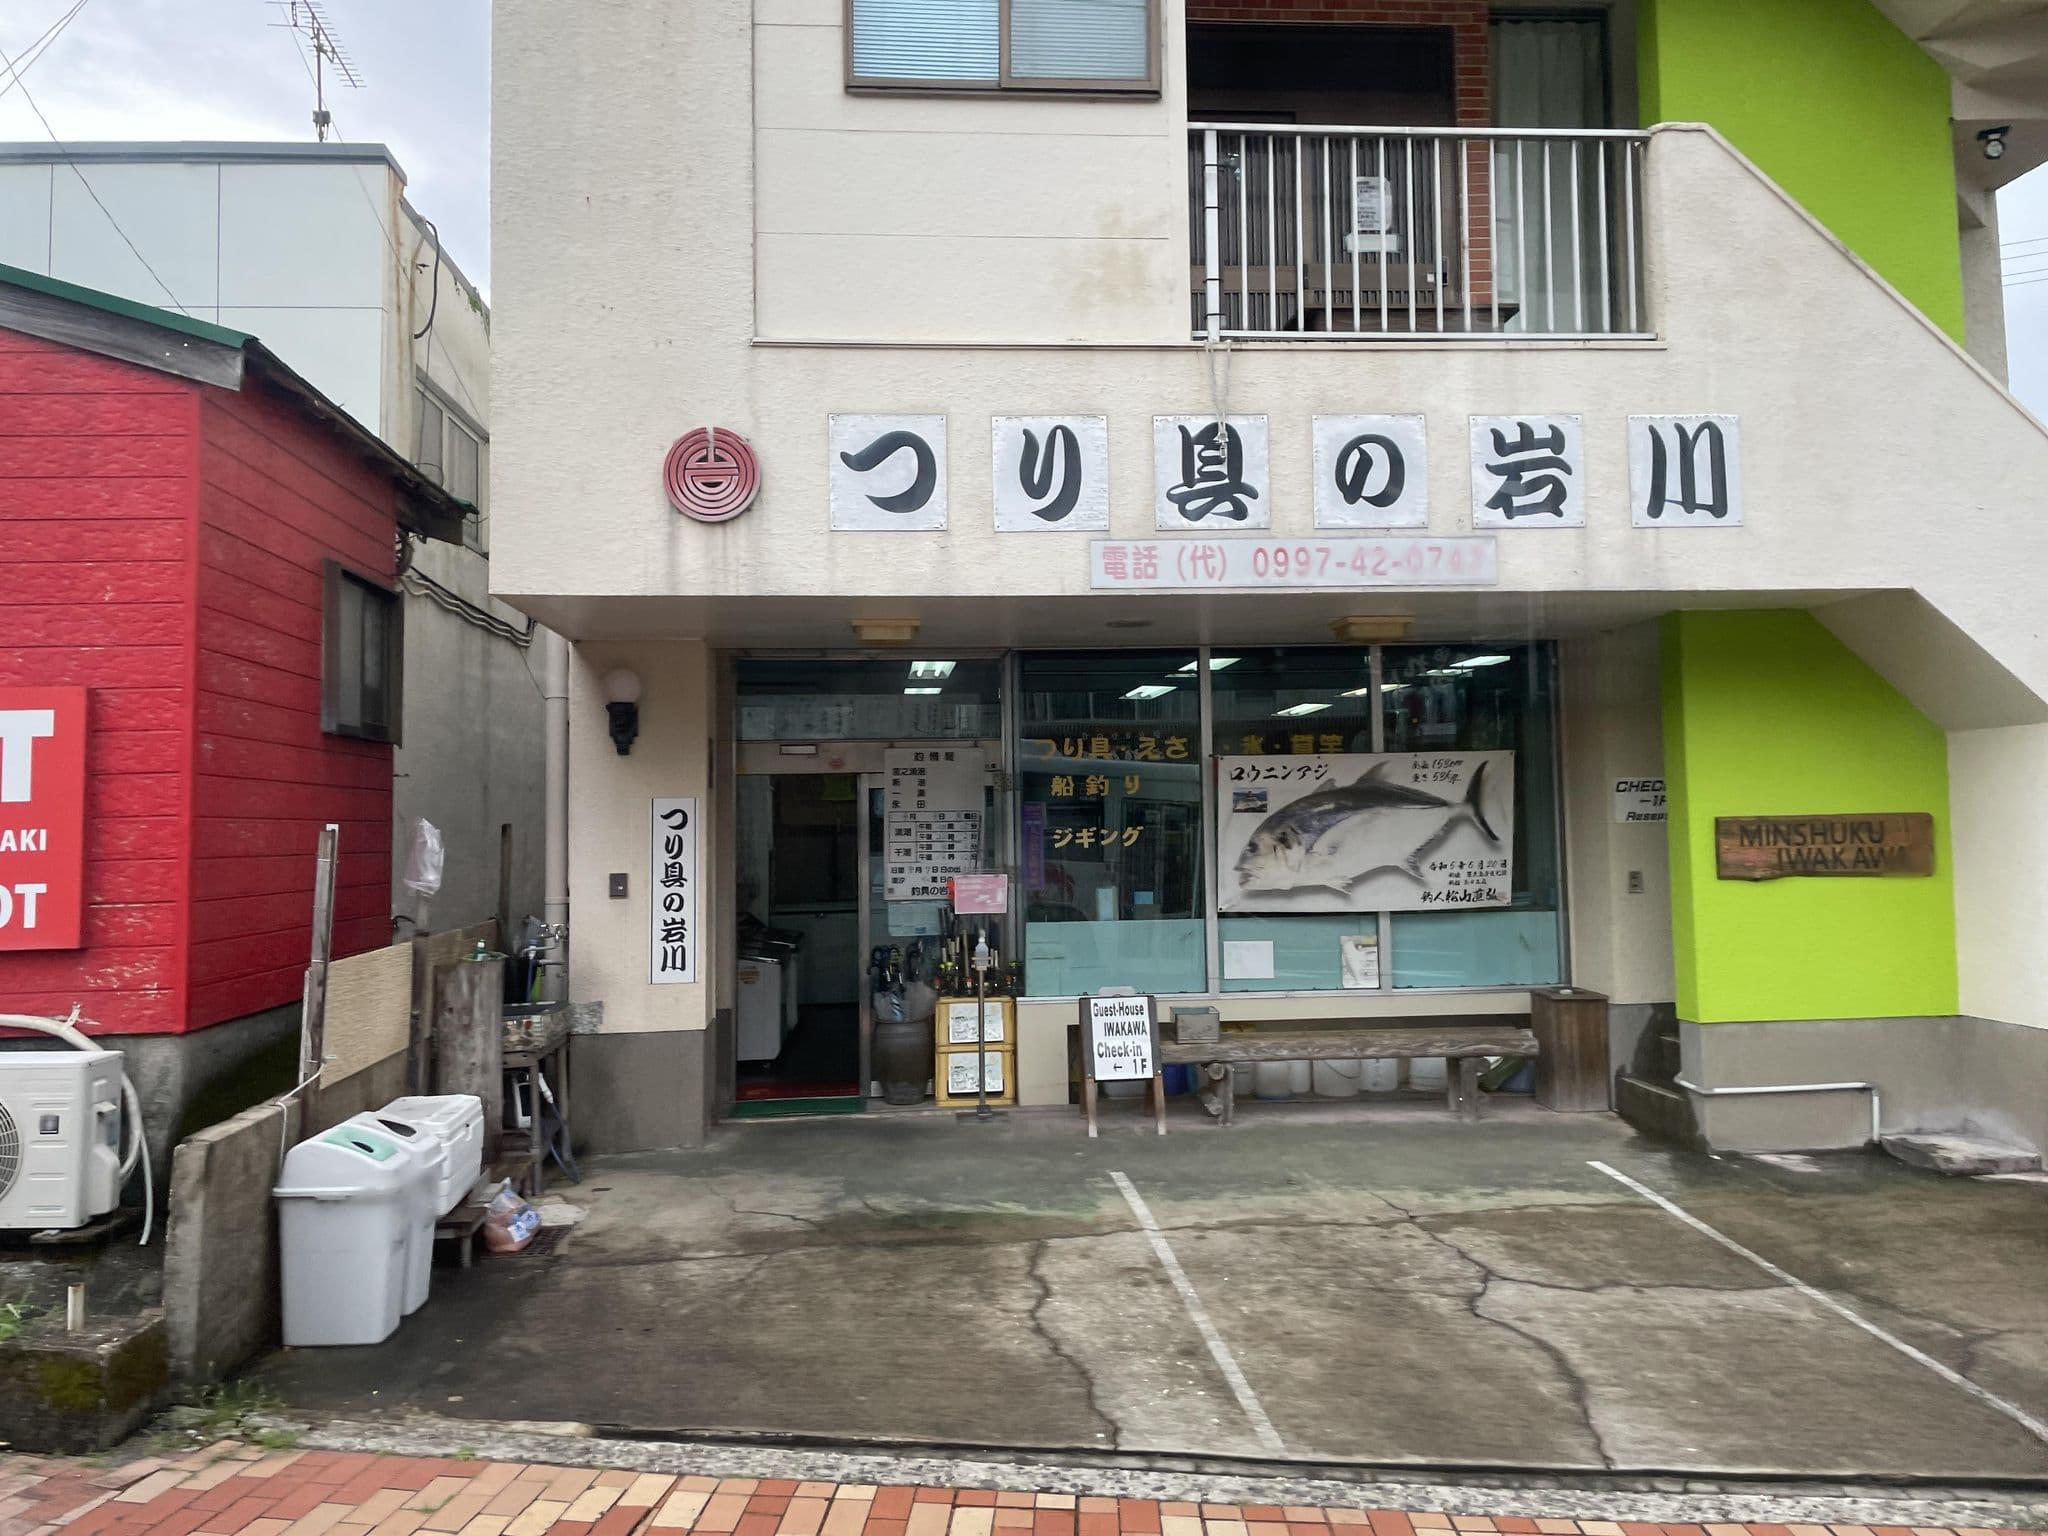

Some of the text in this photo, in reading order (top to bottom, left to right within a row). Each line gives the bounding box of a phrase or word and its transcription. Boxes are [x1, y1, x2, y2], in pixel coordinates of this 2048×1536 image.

[840, 420, 1728, 522] つり具の岩川
[1230, 764, 1329, 782] ロウニンアジ
[1050, 775, 1140, 798] 船釣り
[1616, 780, 1666, 793] CHEC
[1052, 825, 1144, 849] ジギング
[1739, 821, 1886, 846] MINSHUKU
[660, 808, 689, 972] つり具の岩川
[911, 887, 952, 896] 釣具の岩
[0, 883, 47, 929] T
[1093, 1002, 1145, 1017] Guest-House
[1104, 1021, 1148, 1037] IWAKAWA
[1097, 1041, 1143, 1058] Check-in
